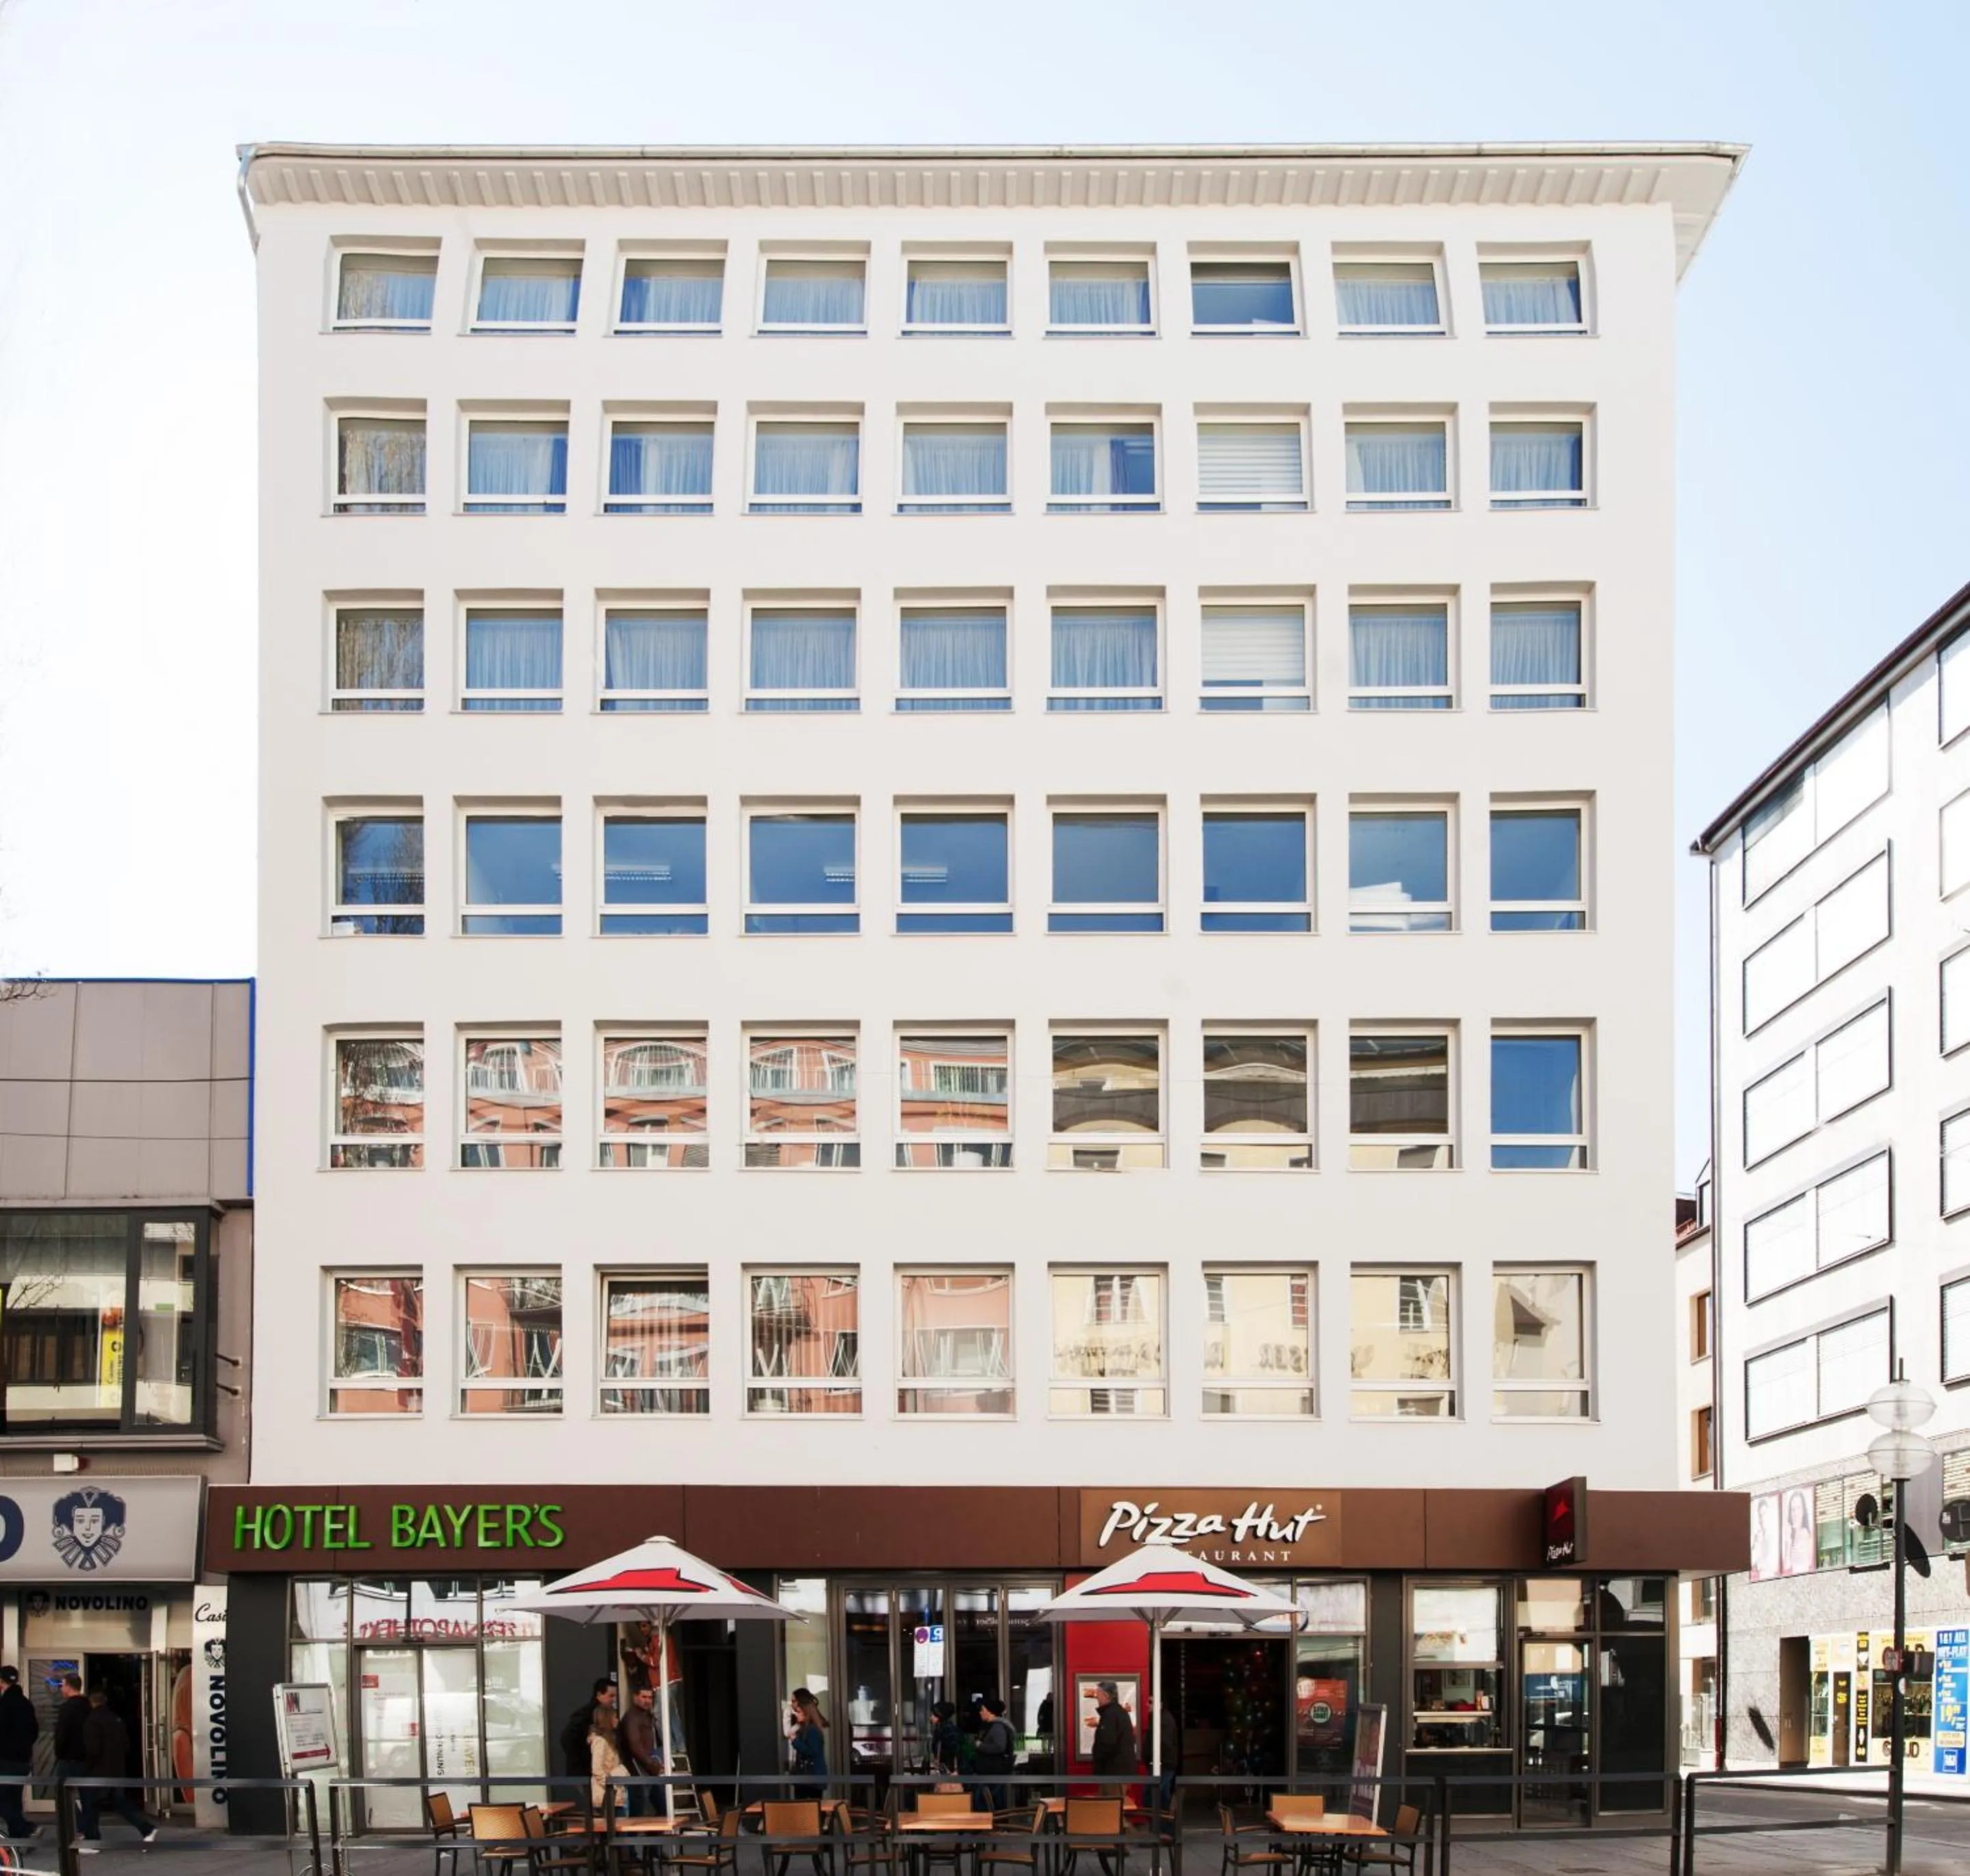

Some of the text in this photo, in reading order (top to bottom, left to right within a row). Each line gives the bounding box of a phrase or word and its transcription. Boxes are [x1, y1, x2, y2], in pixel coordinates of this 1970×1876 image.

[234, 1504, 565, 1550] HOTEL BAYER'S
[1098, 1501, 1327, 1548] Pizza Hut
[1185, 1550, 1291, 1561] AURANT
[55, 1595, 147, 1610] NOVOLINO
[210, 1675, 227, 1804] NOVOLINO
